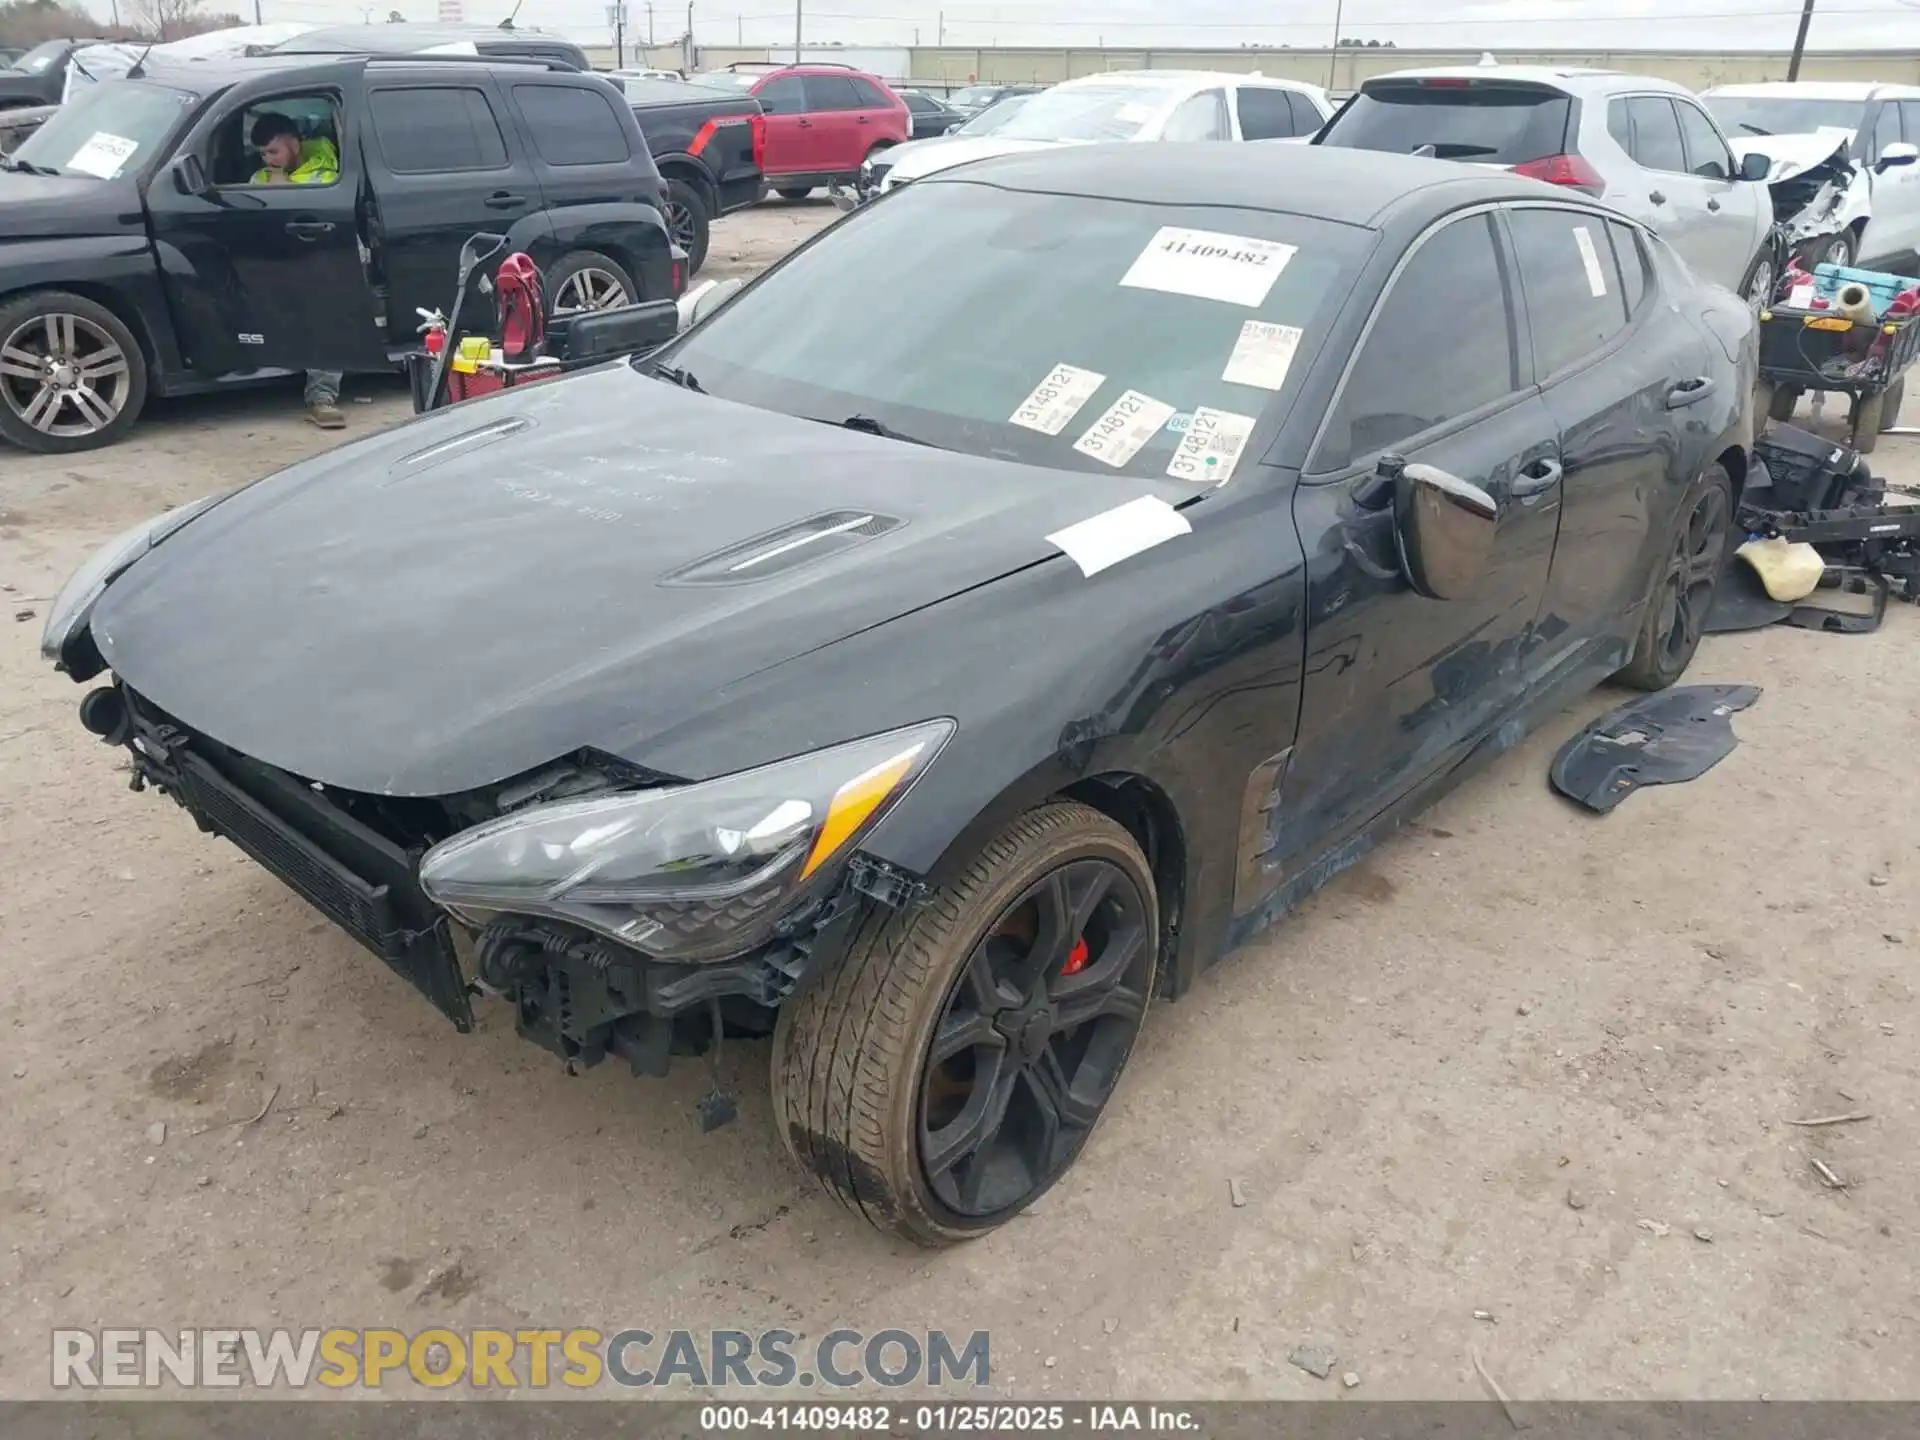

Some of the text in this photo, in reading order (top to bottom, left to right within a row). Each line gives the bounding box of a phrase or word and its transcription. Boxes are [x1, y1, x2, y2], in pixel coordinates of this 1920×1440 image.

[1160, 240, 1269, 266] 41409482
[238, 333, 265, 344] SS
[1019, 367, 1077, 422] 3148121
[1083, 396, 1147, 451] 3148121
[1174, 411, 1220, 473] 3148121
